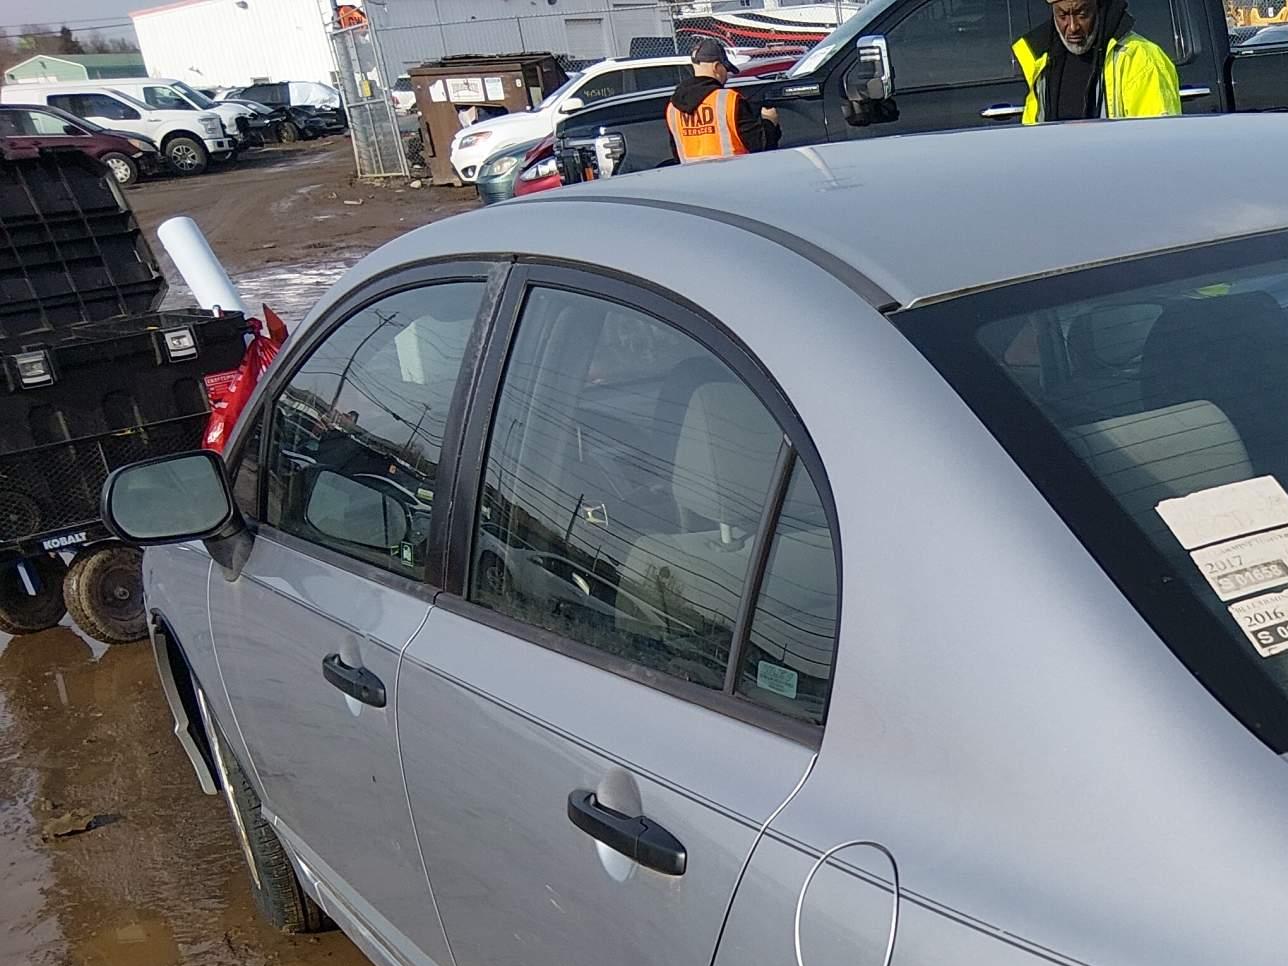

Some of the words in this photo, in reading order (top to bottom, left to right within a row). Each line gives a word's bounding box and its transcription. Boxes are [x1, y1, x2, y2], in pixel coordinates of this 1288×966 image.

[42, 532, 87, 550] KOBALT
[1205, 555, 1243, 574] 2017
[1218, 577, 1231, 590] S
[1235, 564, 1282, 586] 01658
[1244, 608, 1285, 627] 2016
[1257, 630, 1274, 645] S
